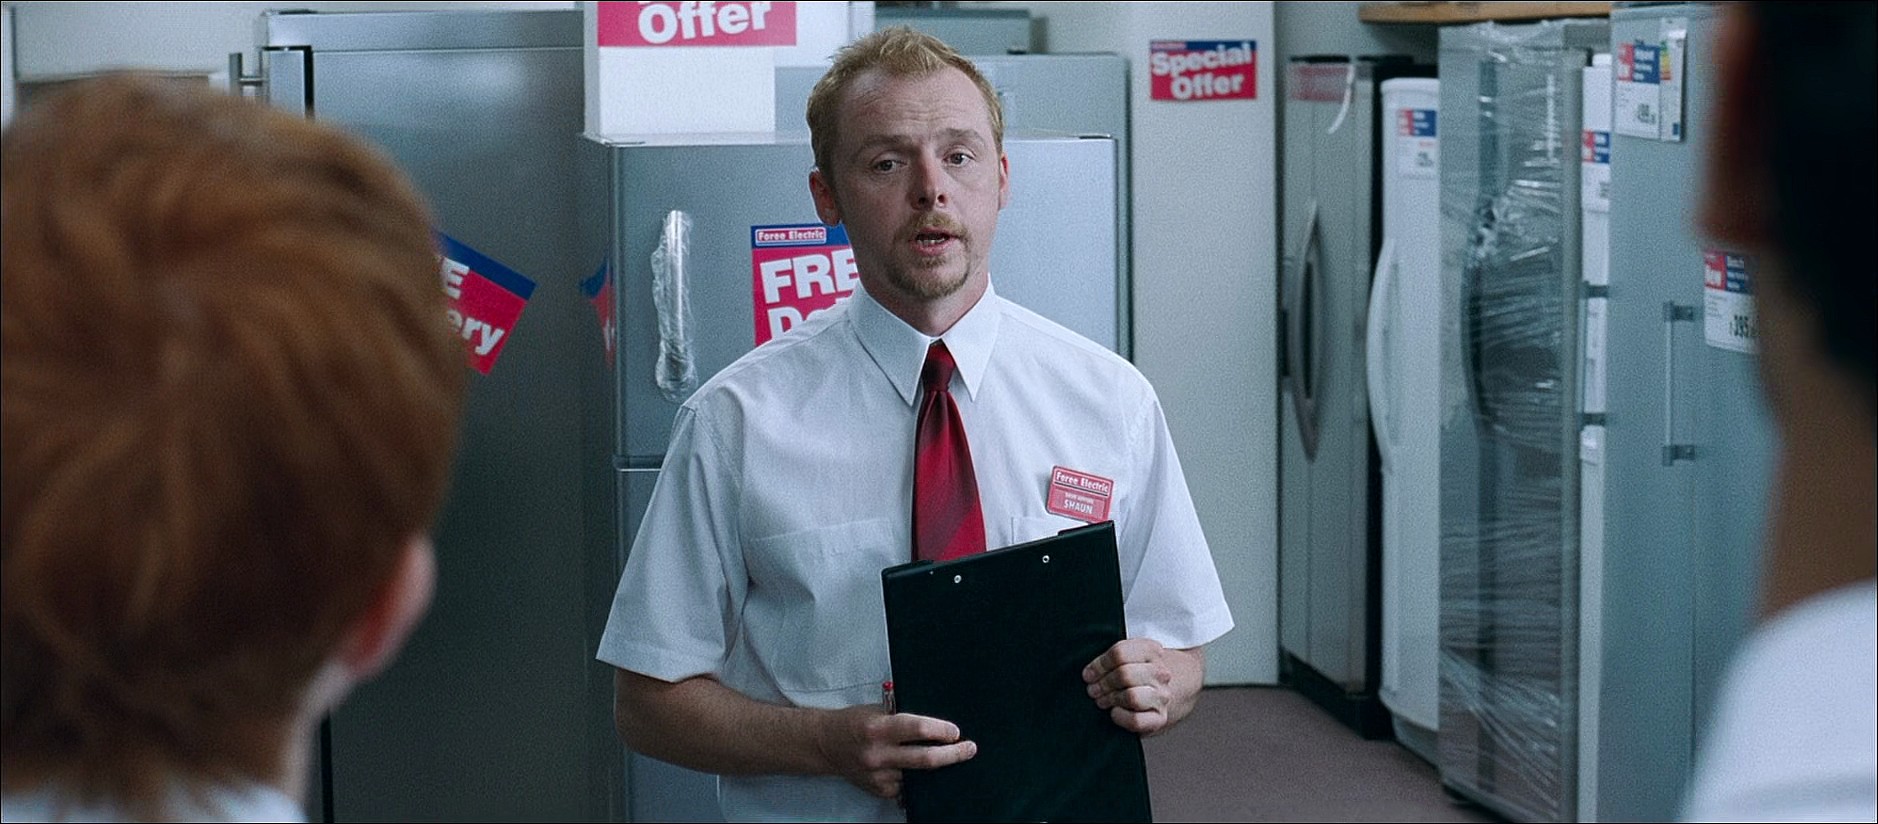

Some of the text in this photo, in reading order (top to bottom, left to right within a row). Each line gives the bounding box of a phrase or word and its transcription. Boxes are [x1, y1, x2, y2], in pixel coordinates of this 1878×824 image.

[638, 2, 771, 44] Offer
[1151, 42, 1251, 78] Special
[1171, 73, 1244, 100] Offer
[788, 229, 824, 240] Electric
[1080, 477, 1108, 492] Electric
[1063, 499, 1093, 514] SHAUN
